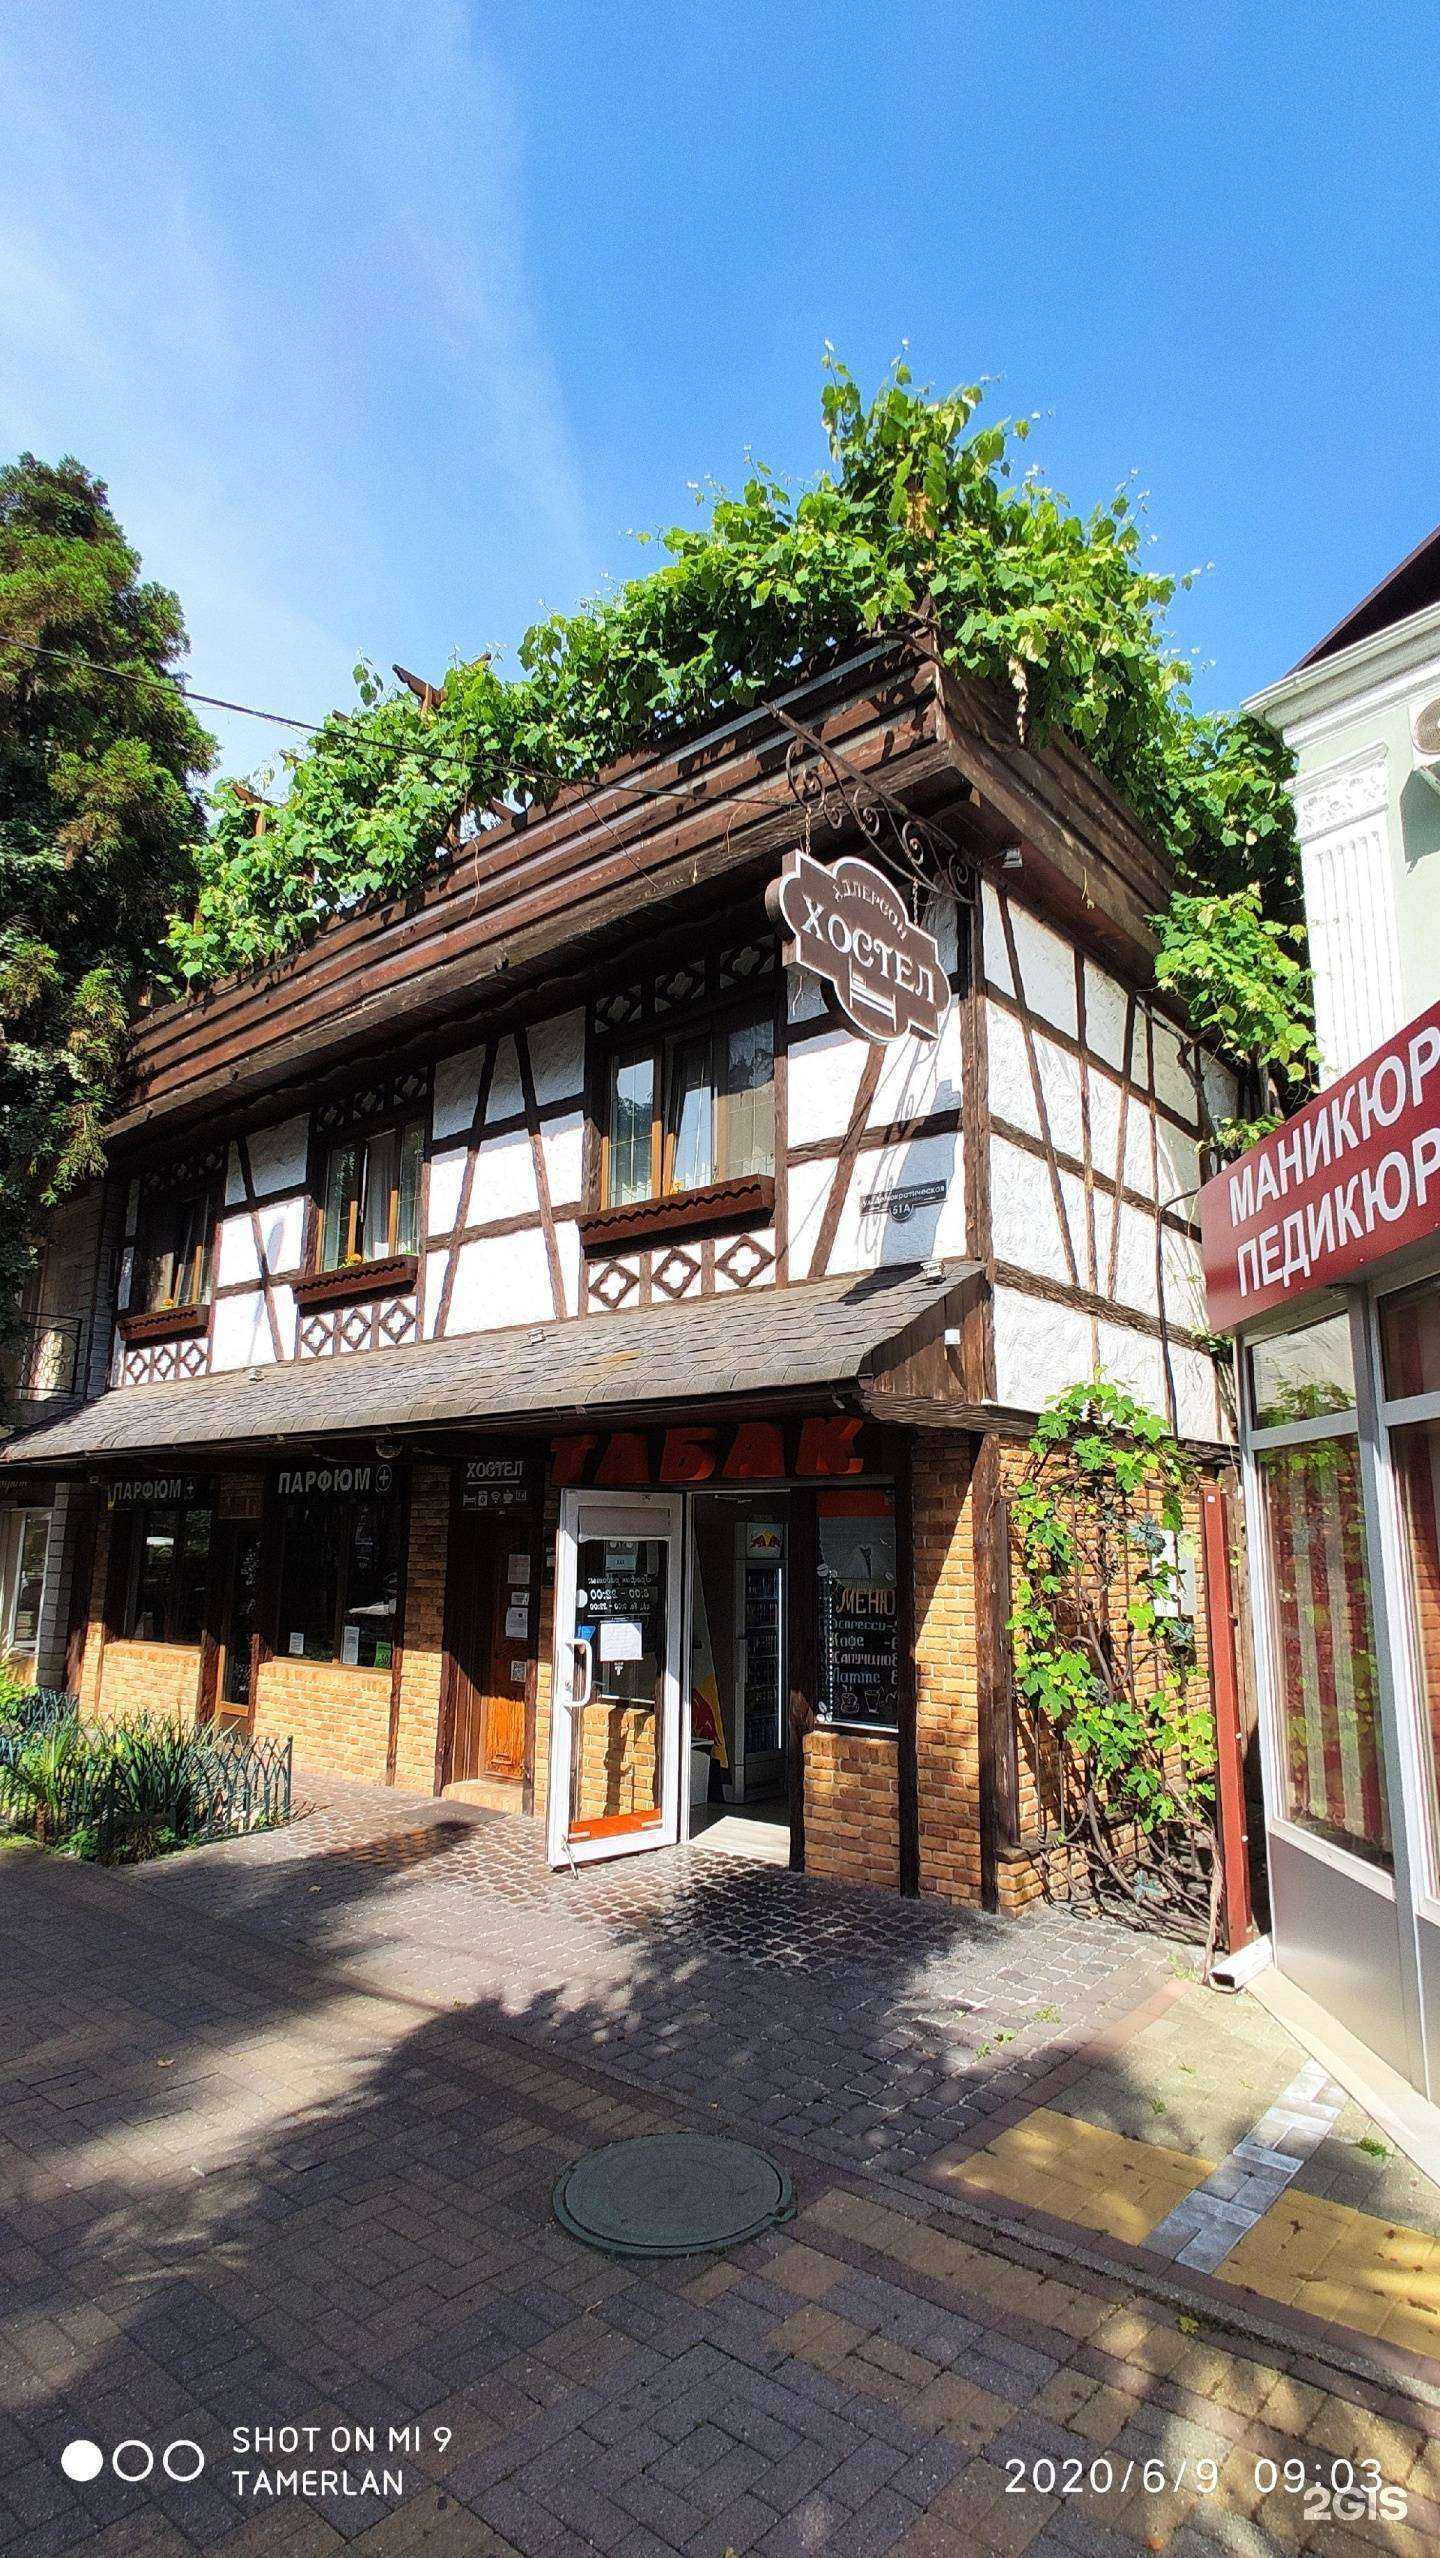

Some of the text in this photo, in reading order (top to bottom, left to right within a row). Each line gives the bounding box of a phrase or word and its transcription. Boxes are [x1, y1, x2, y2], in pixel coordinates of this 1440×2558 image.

[801, 892, 934, 1004] ХОСТЕЛ
[1228, 1026, 1440, 1228] МАНИКЮР
[1237, 1127, 1440, 1298] ПЕДИКЮР
[466, 1460, 525, 1479] ХОСТЕЛ
[550, 1416, 864, 1485] ТАБАК
[113, 1478, 182, 1501] ПАРФЮМ
[277, 1467, 371, 1494] ПАРФЮМ
[835, 1587, 896, 1616] МЕНЮ
